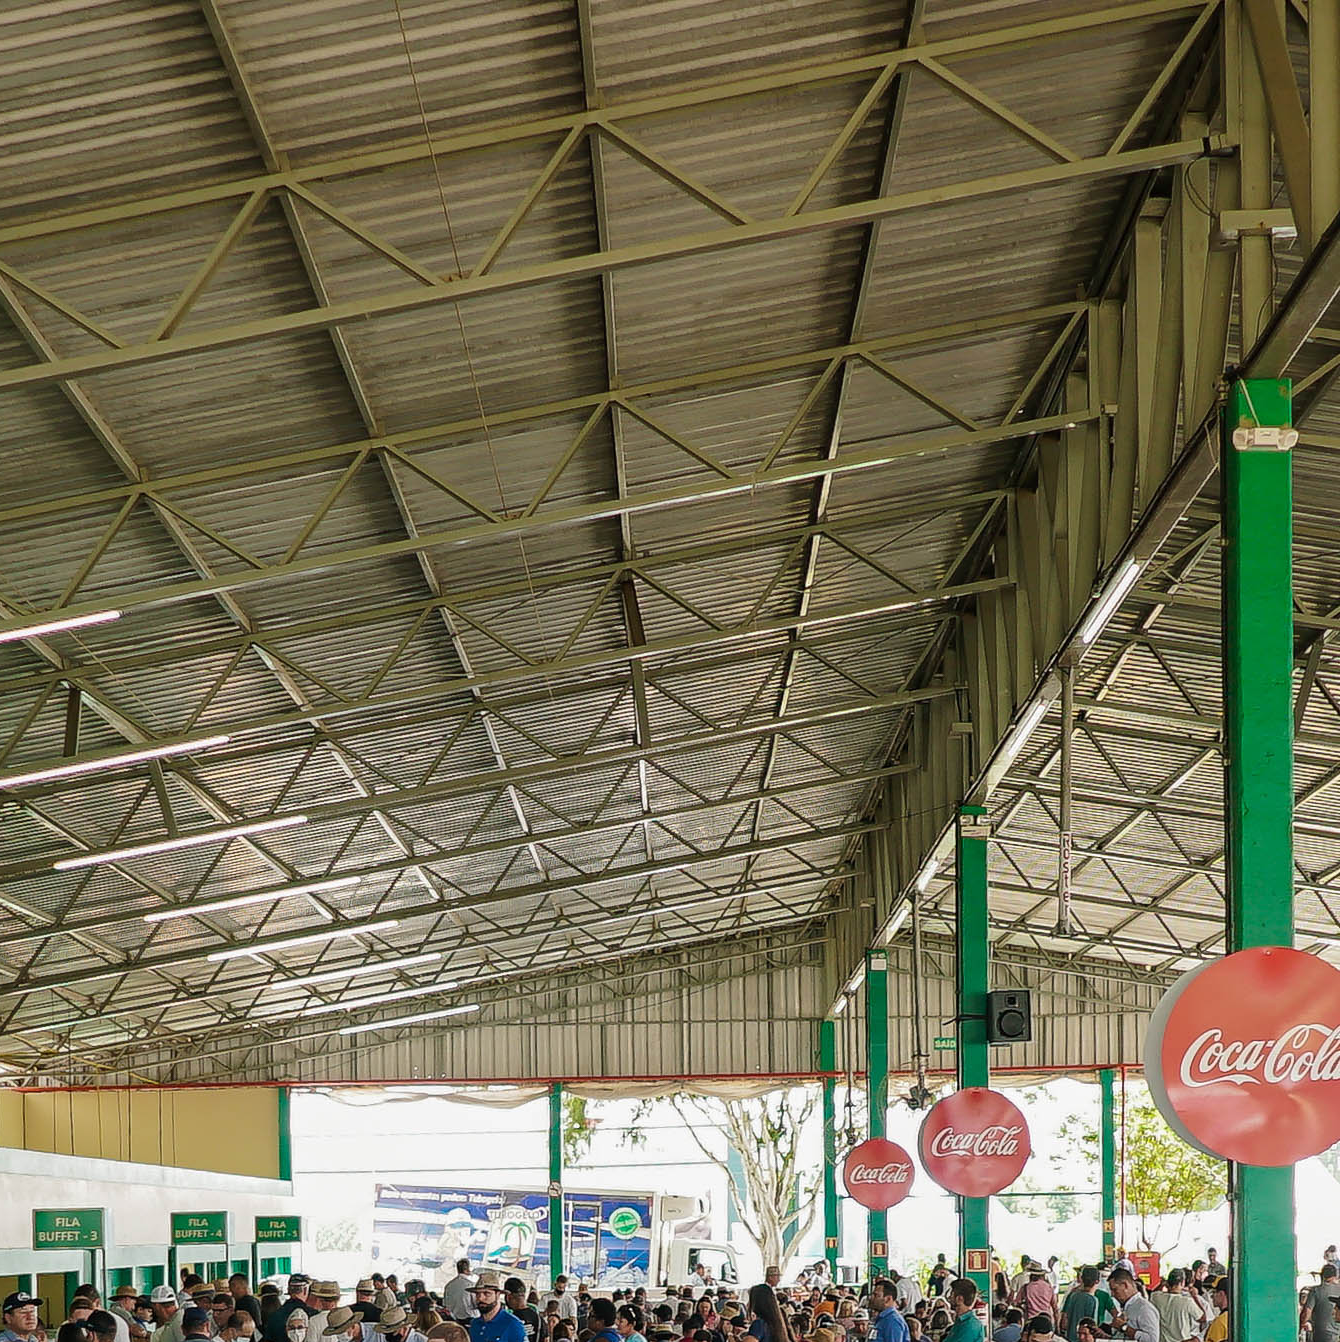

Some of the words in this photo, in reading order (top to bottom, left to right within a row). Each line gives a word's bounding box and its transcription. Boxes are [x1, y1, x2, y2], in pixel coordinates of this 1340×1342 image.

[931, 1126, 1022, 1157] Coca-Cola
[849, 1162, 910, 1184] Coca-Cola
[55, 1217, 81, 1227] FILA
[188, 1218, 208, 1227] FILA
[39, 1231, 81, 1241] BUFFET
[91, 1231, 98, 1240] 3
[175, 1229, 208, 1238] BUFFET
[216, 1229, 222, 1237] 4
